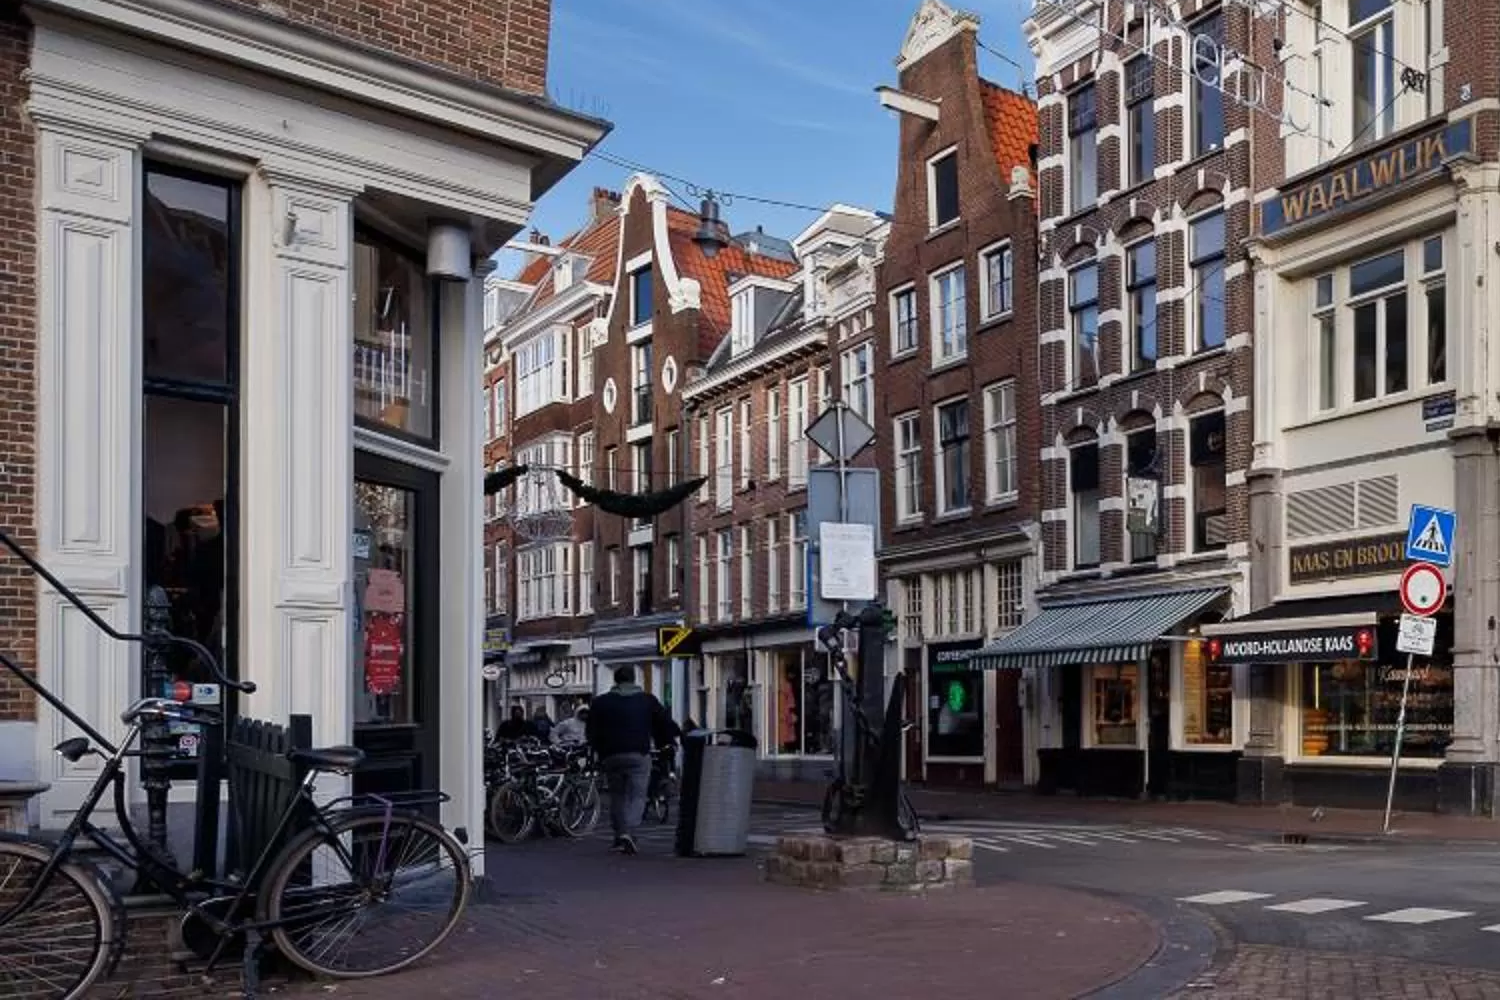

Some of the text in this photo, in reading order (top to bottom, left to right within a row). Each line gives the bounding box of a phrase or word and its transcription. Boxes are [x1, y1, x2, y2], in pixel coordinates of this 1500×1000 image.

[1281, 134, 1448, 223] WAALWIJK
[1292, 553, 1329, 573] KAAS
[1334, 549, 1353, 569] EN
[1223, 635, 1353, 657] NOORD-HOLLANDSE KAAS
